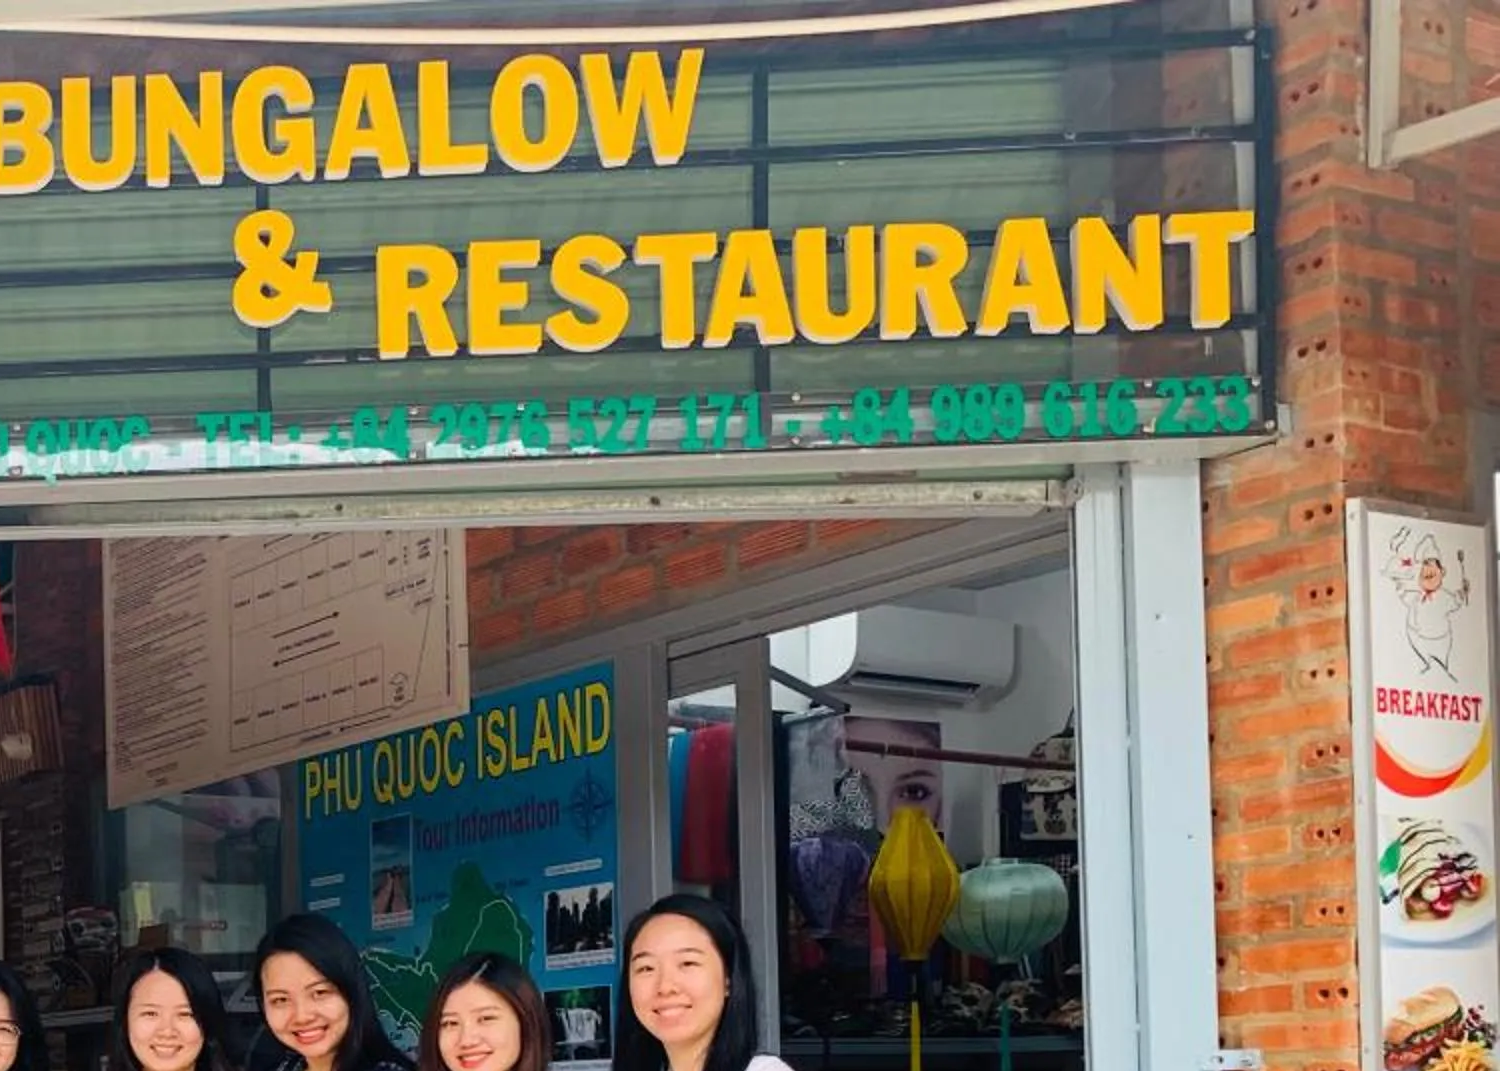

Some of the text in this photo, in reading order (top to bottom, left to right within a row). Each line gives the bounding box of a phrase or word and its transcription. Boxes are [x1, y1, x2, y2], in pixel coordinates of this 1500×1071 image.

[232, 209, 1255, 360] & RESTAURANT
[26, 415, 150, 487] QUOC
[320, 403, 410, 462] +84
[569, 394, 657, 454] 527
[681, 391, 767, 450] 171
[819, 385, 913, 445] +84
[931, 382, 1026, 442] 989
[1041, 376, 1138, 437] 616
[1155, 372, 1250, 433] 233
[305, 748, 362, 820] PHU
[373, 720, 465, 806] QUOC
[477, 682, 611, 780] ISLAND
[1376, 687, 1483, 723] BREAKFAST
